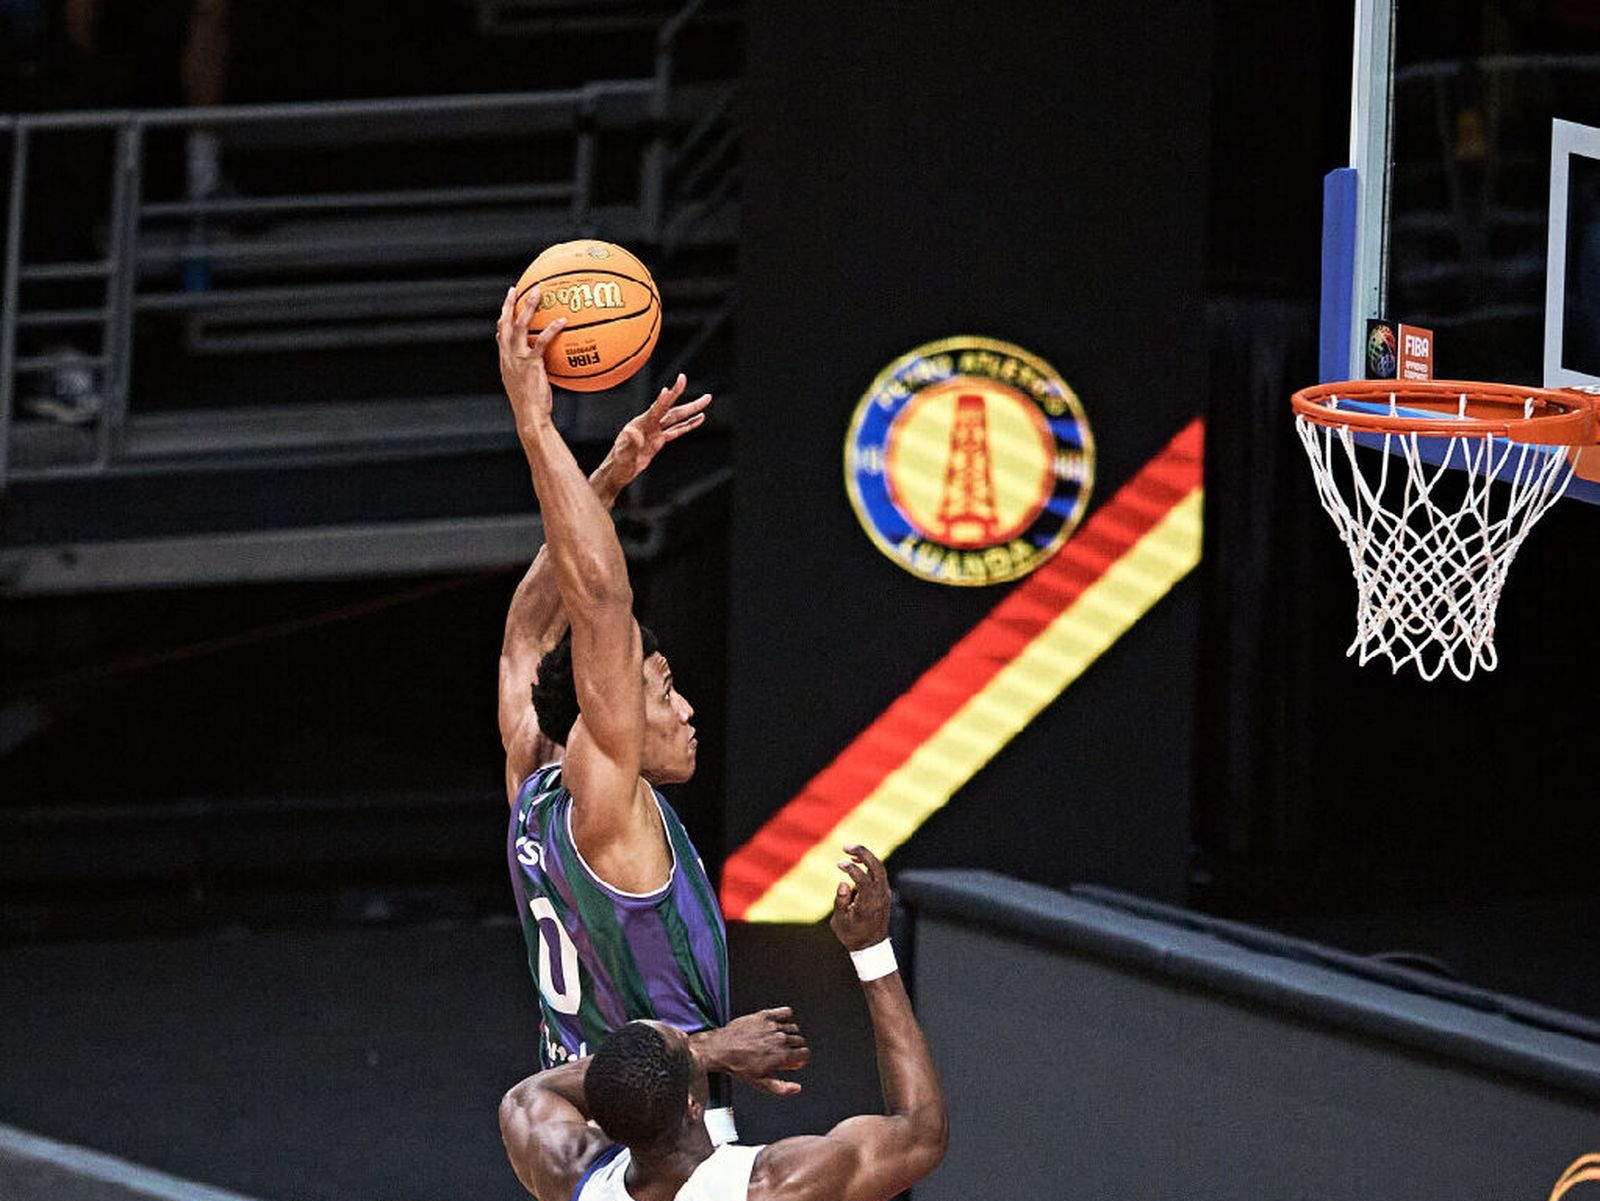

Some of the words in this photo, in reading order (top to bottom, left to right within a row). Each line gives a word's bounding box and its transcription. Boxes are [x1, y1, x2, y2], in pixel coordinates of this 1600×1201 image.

[539, 281, 625, 313] Wilso
[1405, 334, 1429, 358] FIBA
[567, 352, 600, 368] FIBA
